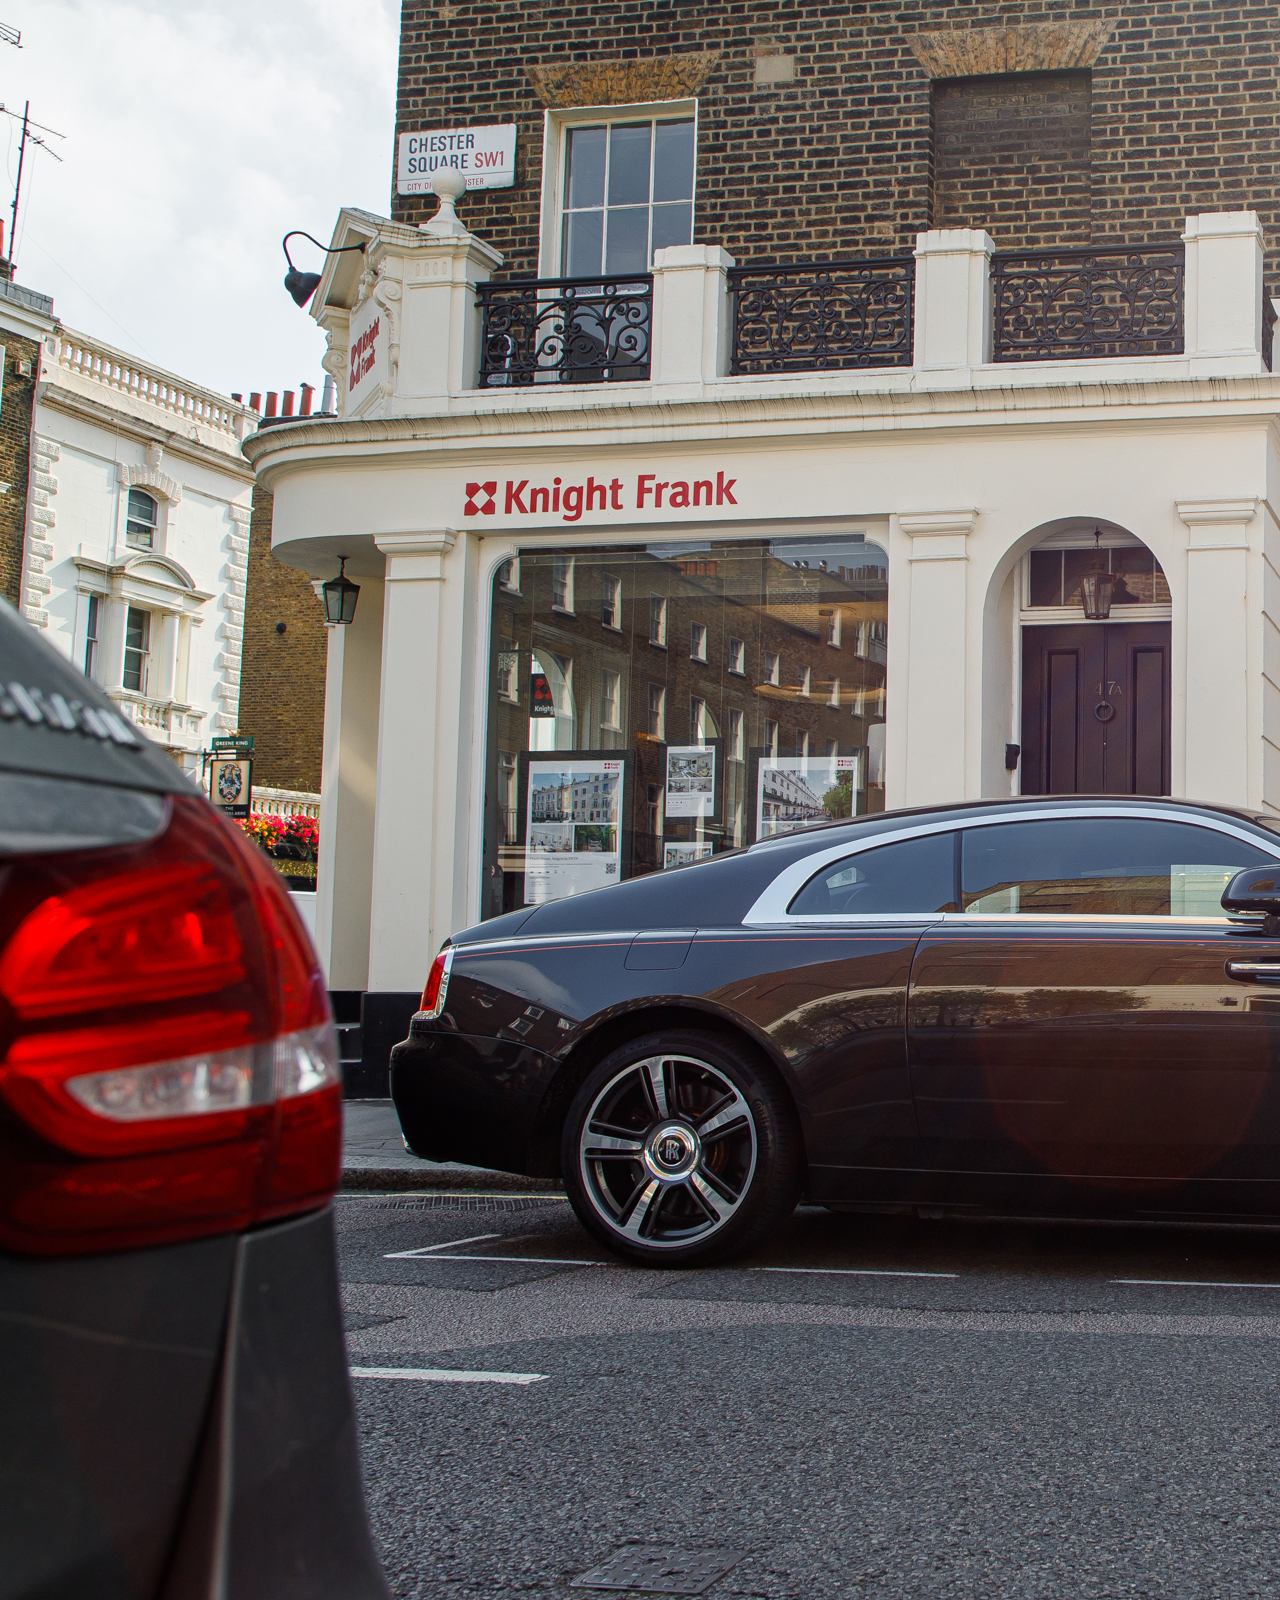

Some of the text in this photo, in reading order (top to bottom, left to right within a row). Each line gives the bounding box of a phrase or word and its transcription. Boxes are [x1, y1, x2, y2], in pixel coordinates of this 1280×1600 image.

[408, 133, 475, 154] CHESTER
[408, 150, 504, 174] SQUARE SW1
[407, 183, 422, 191] CITY
[465, 177, 484, 187] STER
[362, 316, 380, 354] Knight
[361, 348, 376, 379] Frank
[504, 471, 738, 522] Knight Frank
[1093, 681, 1123, 696] 47A
[534, 705, 554, 714] Knight
